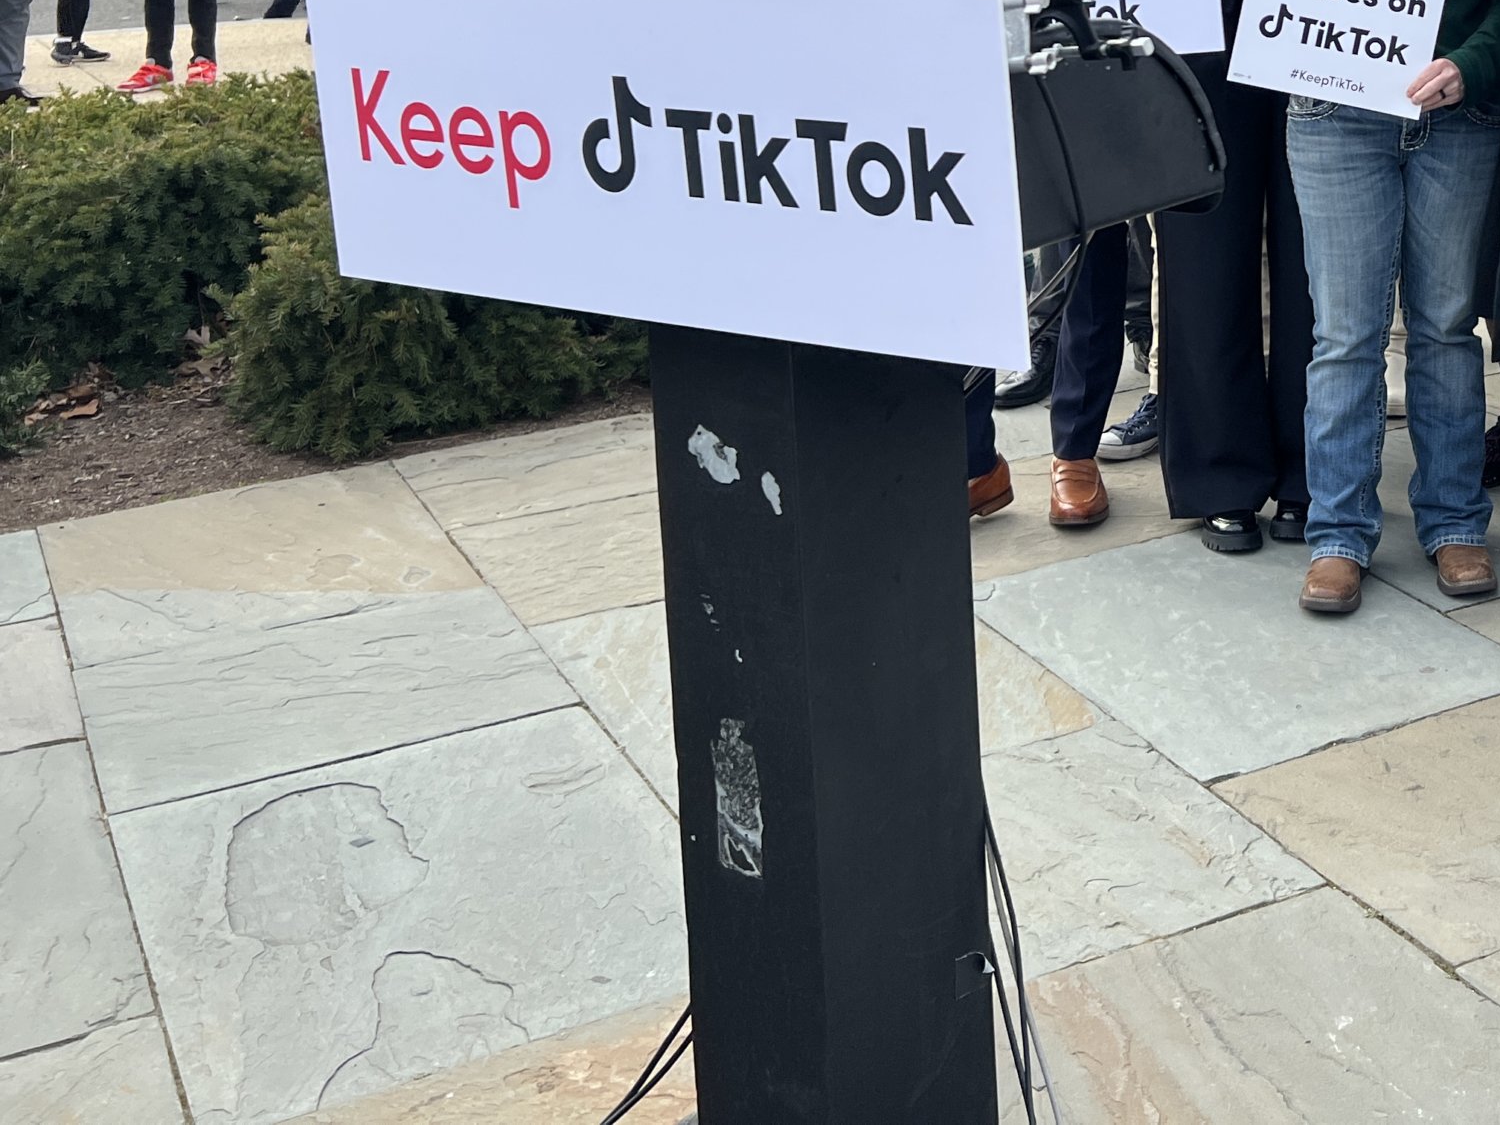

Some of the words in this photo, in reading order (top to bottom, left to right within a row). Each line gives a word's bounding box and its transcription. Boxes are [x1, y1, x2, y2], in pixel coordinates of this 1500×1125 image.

[1298, 16, 1410, 66] TikTok
[1290, 69, 1366, 94] #KeepTikTok
[350, 67, 551, 209] Keep
[664, 108, 974, 227] TikTok
